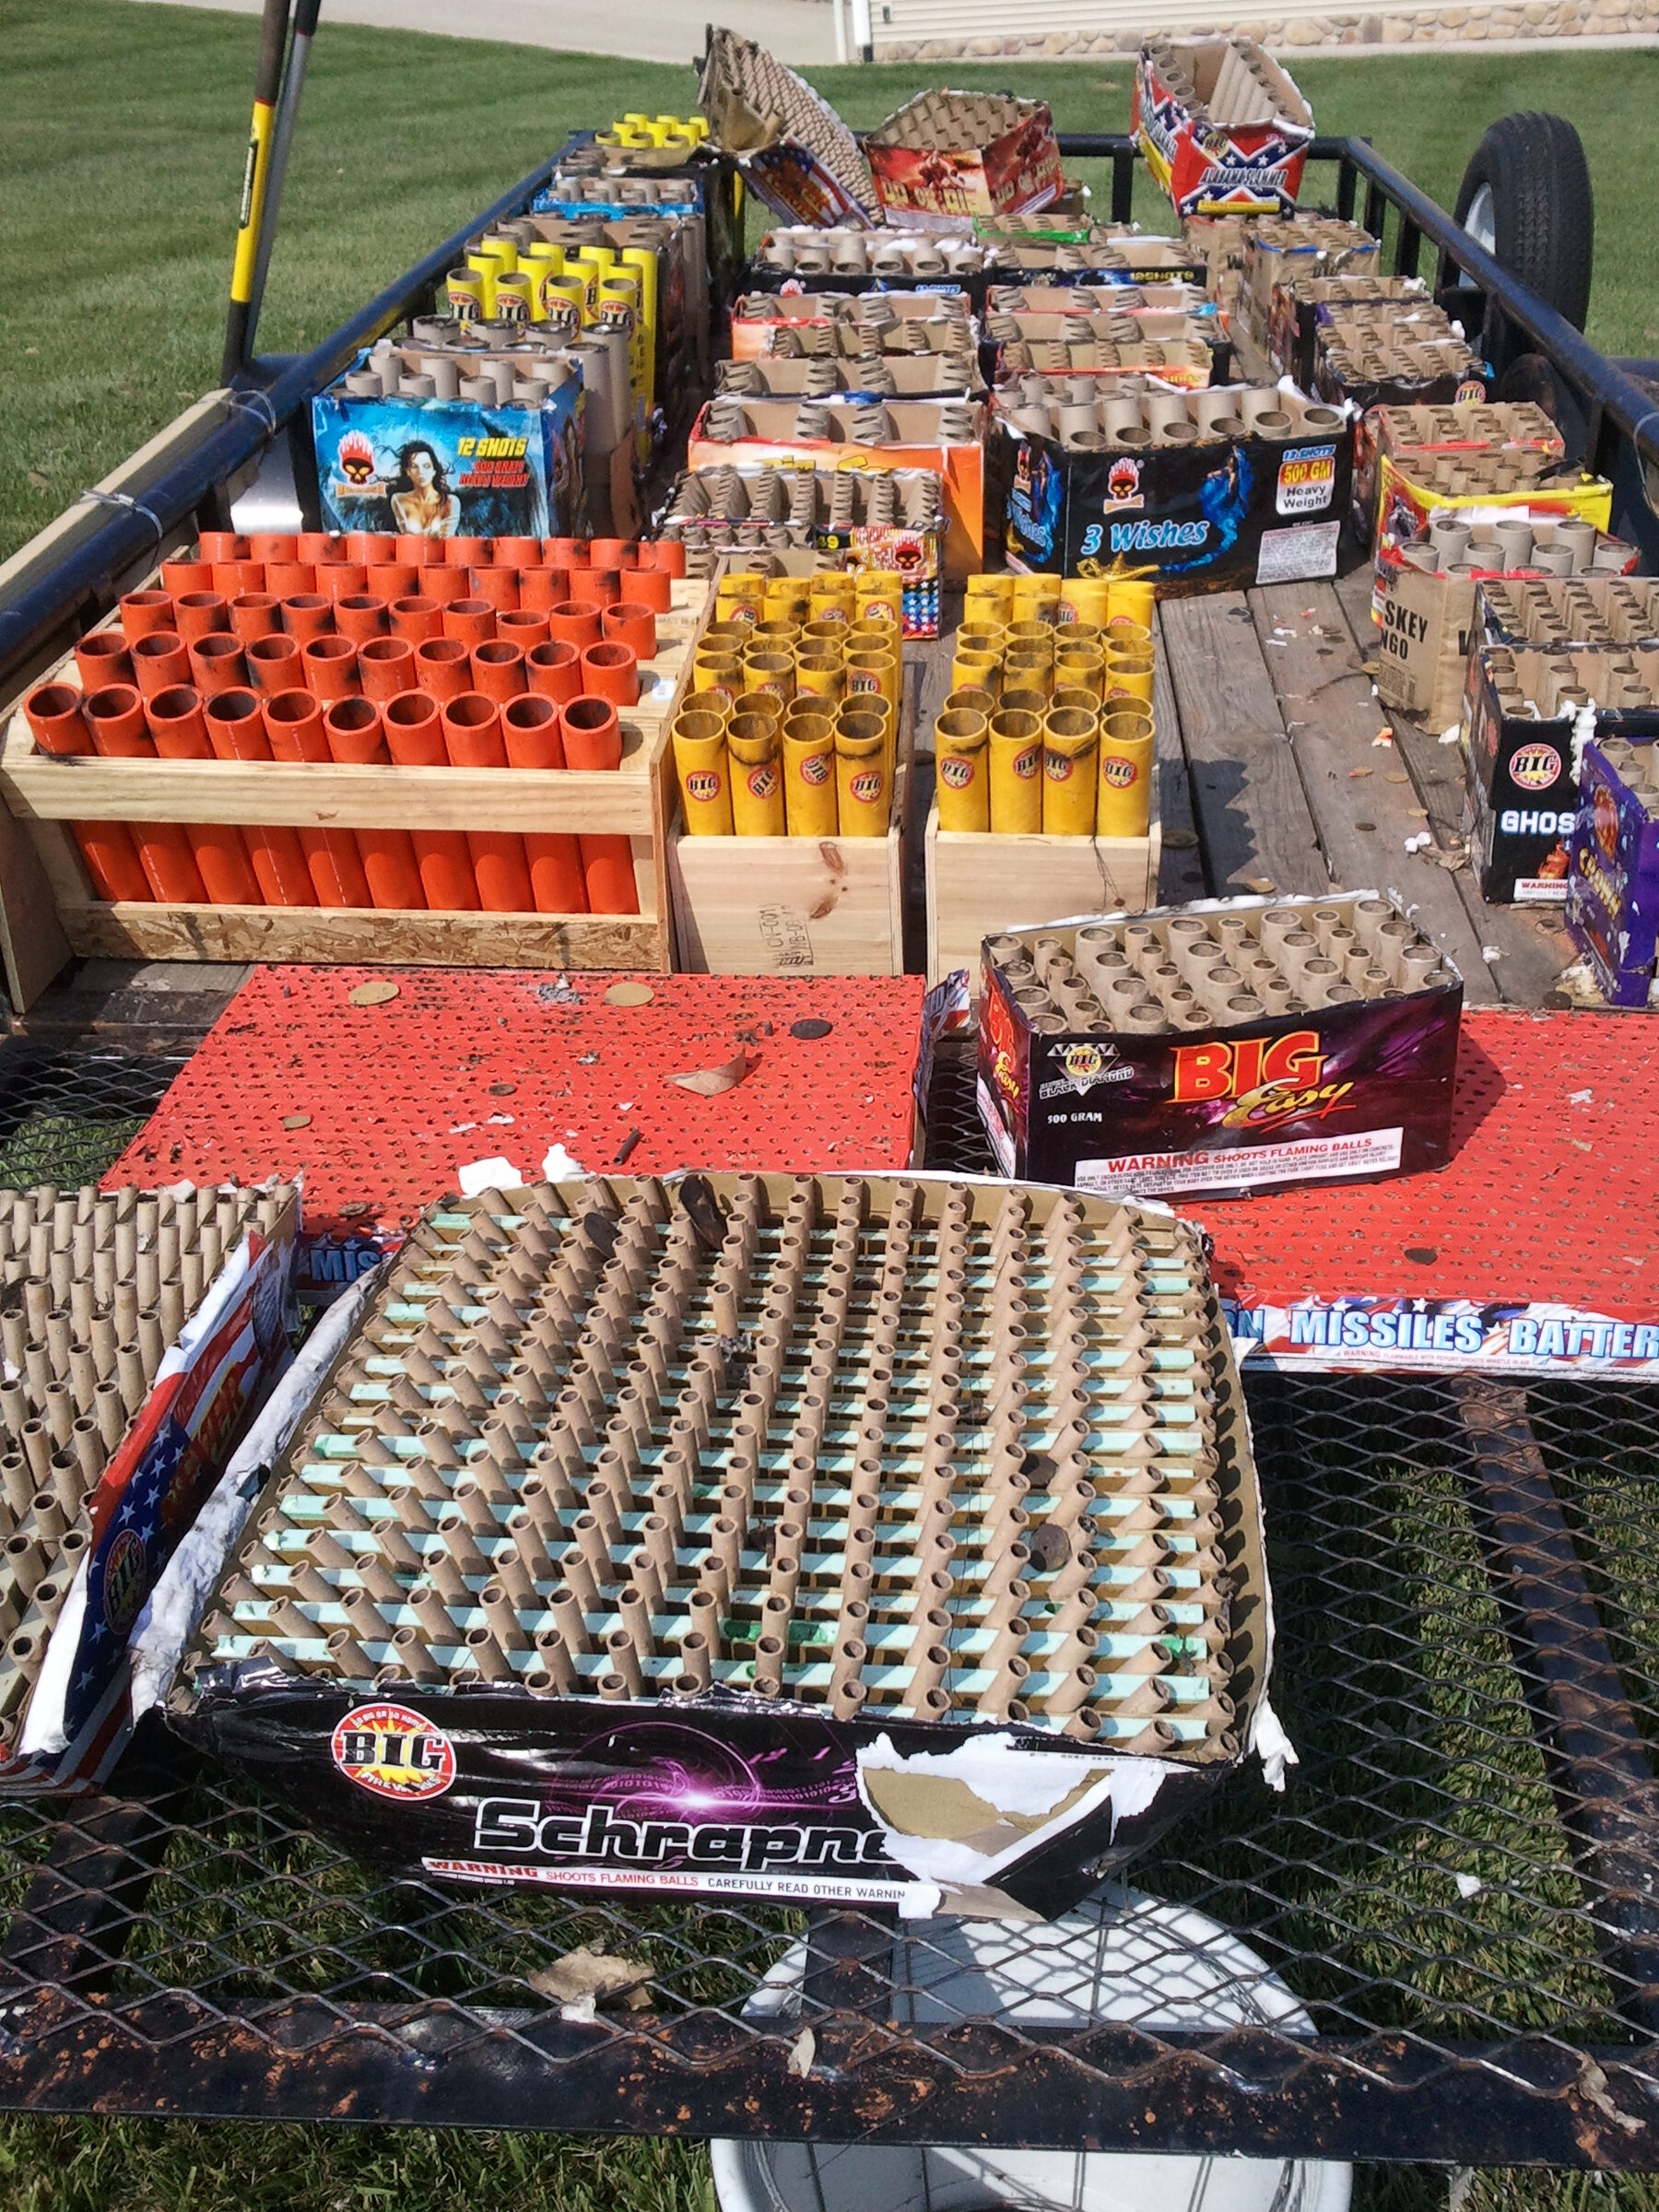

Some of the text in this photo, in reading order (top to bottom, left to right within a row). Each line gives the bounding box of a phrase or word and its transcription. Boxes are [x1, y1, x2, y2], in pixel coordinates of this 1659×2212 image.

[1199, 167, 1288, 187] ALABAMA SLAMMER
[457, 437, 529, 459] 12 SHOTS
[1298, 444, 1335, 458] SHOTS
[1284, 461, 1332, 484] 500 GM
[1284, 495, 1328, 509] Weight
[1287, 485, 1326, 497] Heavy
[1080, 518, 1211, 555] 3 Wishes
[1384, 599, 1428, 643] SKEY
[941, 762, 969, 778] BIG
[1106, 762, 1133, 777] BIG
[1513, 754, 1557, 772] BIG
[688, 777, 716, 792] BIG
[752, 769, 774, 795] BIG
[853, 777, 880, 791] BIG
[1500, 809, 1576, 834] GHOS
[1165, 1030, 1329, 1103] BIG
[1040, 1066, 1135, 1100] BLACK DIAMOND
[1222, 1077, 1357, 1130] Easy
[1047, 1112, 1102, 1124] 500 GRAM
[1108, 1150, 1209, 1173] WARNING
[1213, 1149, 1267, 1165] SHOOTS
[1269, 1144, 1329, 1159] FLAMING
[1332, 1137, 1373, 1151] BALLS
[1289, 1309, 1482, 1353] MISSILES
[1507, 1317, 1659, 1359] BATTER
[1343, 1349, 1381, 1359] WARNING
[339, 1730, 446, 1772] BIG
[428, 1860, 538, 1878] WARNING
[546, 1870, 596, 1883] SHOOTS
[600, 1873, 655, 1886] FLAMING
[660, 1875, 699, 1887] BALLS
[708, 1877, 772, 1892] CAREFULLY
[778, 1882, 808, 1894] READ
[814, 1884, 853, 1897] OTHER
